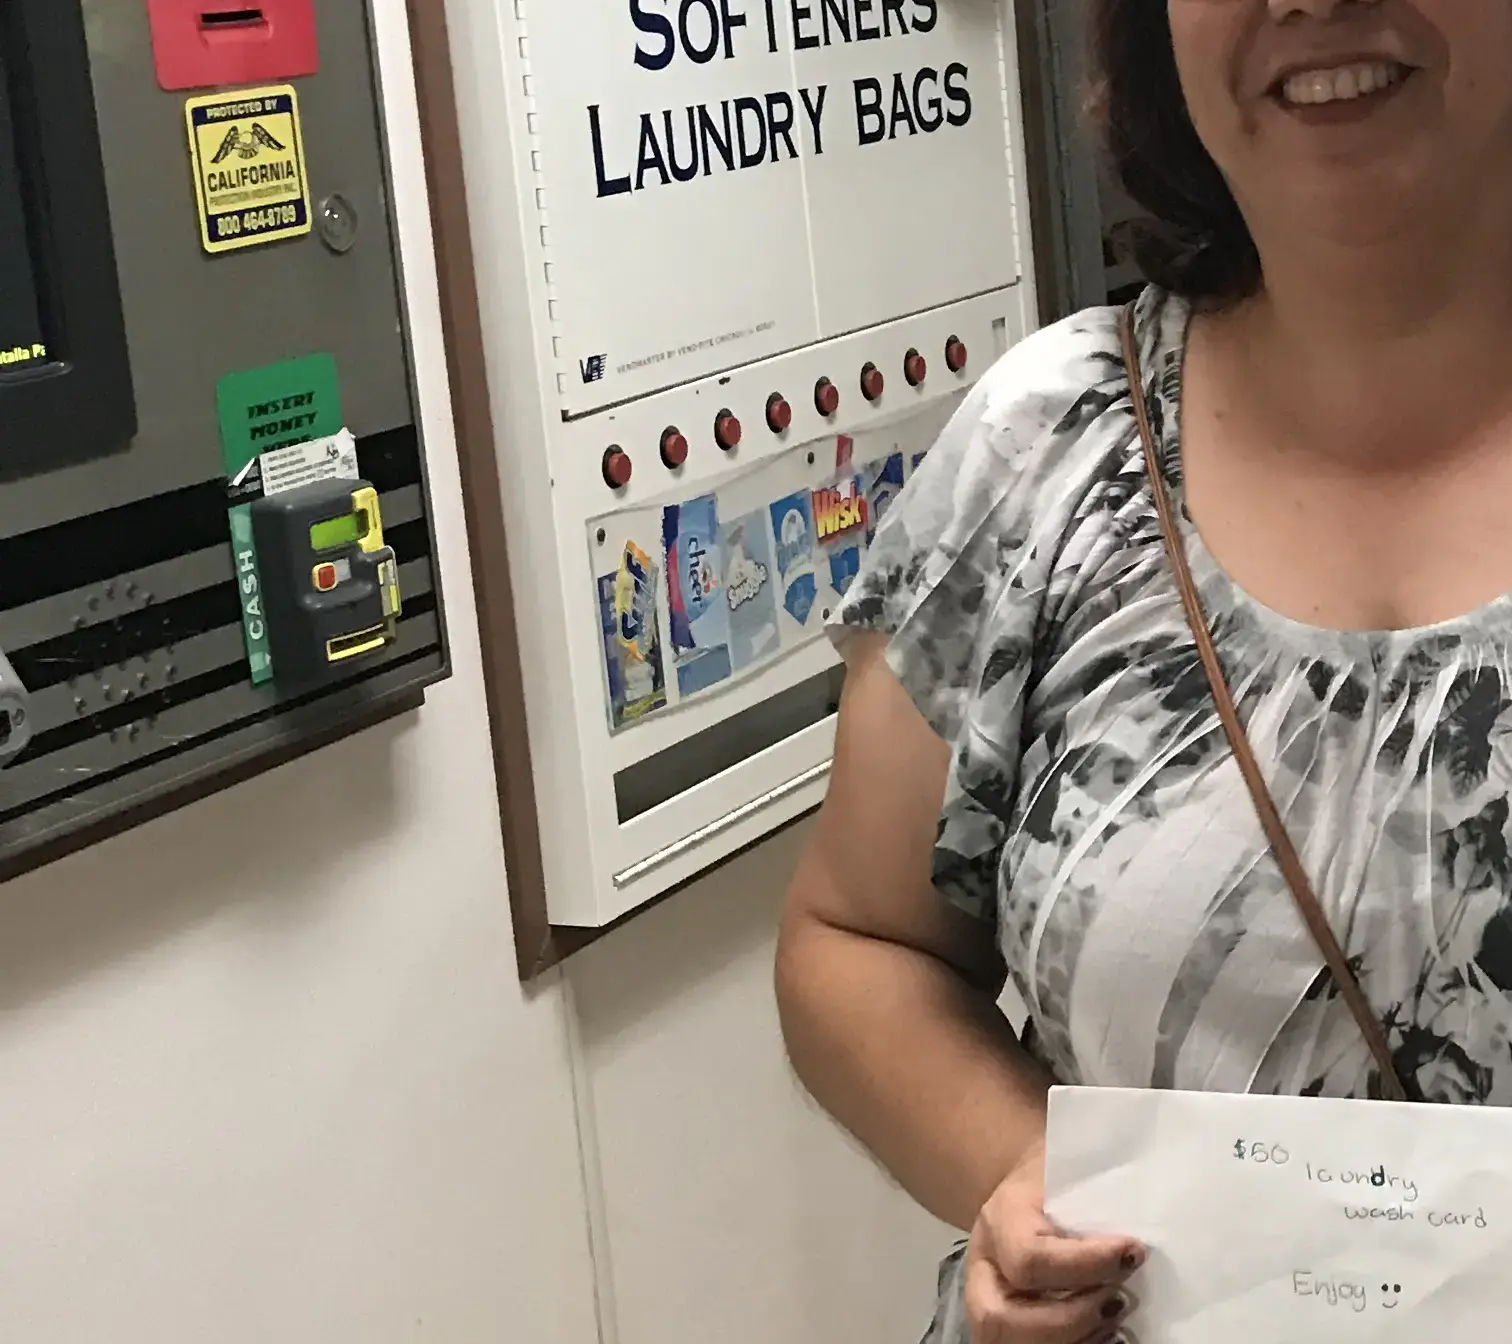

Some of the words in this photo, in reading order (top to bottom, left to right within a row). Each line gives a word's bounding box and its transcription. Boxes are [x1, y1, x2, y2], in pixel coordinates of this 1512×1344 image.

[206, 102, 262, 119] PROTECTED
[265, 99, 278, 111] BY
[587, 85, 827, 198] LAUNDRY
[854, 62, 972, 146] BAGS
[207, 160, 295, 192] CALIFORNIA
[217, 215, 240, 236] 800
[247, 390, 316, 419] INSERT
[249, 411, 318, 441] MONEY
[813, 480, 864, 540] Wisk
[237, 549, 265, 641] CASH
[1233, 1138, 1290, 1165] $50
[1305, 1163, 1419, 1202] laundry
[1344, 1206, 1414, 1222] wash
[1427, 1207, 1488, 1230] card
[1293, 1270, 1367, 1313] Enjoy
